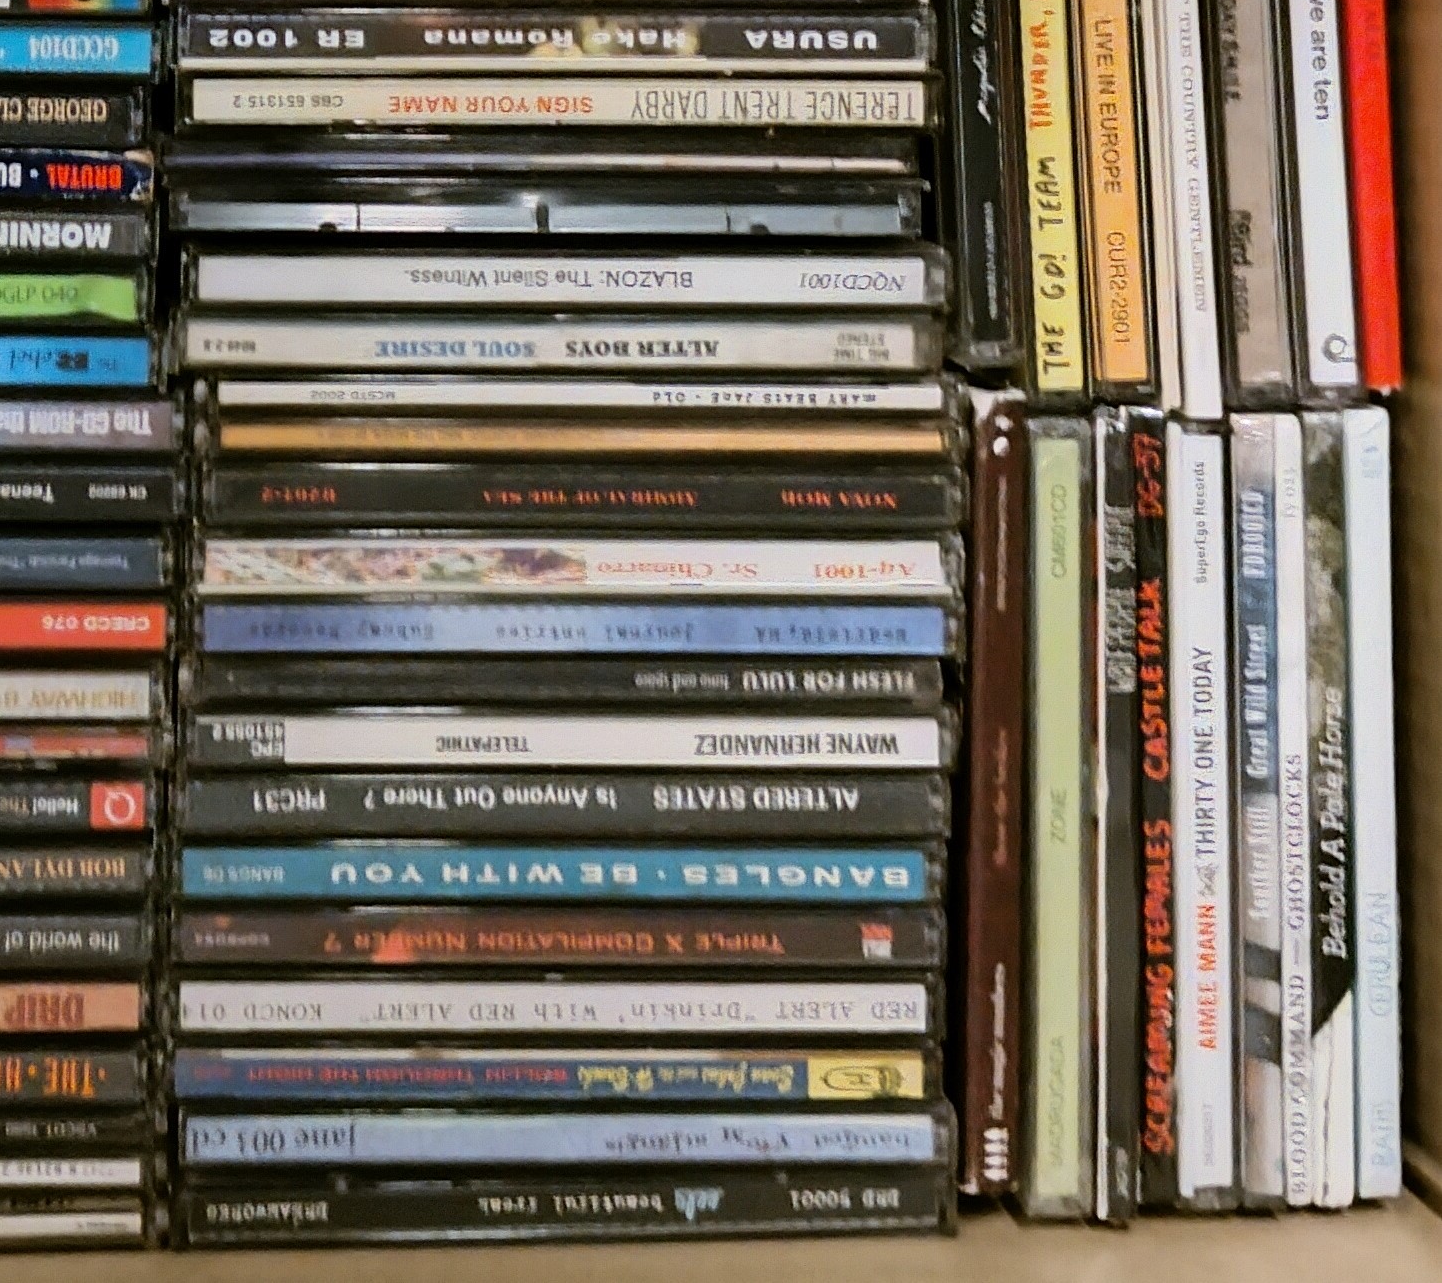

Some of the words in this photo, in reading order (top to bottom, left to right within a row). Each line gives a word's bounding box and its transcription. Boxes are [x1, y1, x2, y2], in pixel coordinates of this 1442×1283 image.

[208, 29, 298, 49] 1002
[317, 29, 364, 49] ER
[423, 28, 574, 49] Romana
[743, 29, 878, 50] USURA
[1092, 17, 1115, 69] LIVE
[1309, 30, 1329, 74] are
[1095, 74, 1116, 97] IN
[1312, 80, 1332, 121] ten
[1097, 101, 1122, 195] EUROPE
[46, 162, 123, 190] BRUTAL
[1037, 155, 1064, 230] TEAM
[493, 268, 550, 288] Silent
[556, 269, 592, 288] The
[598, 269, 693, 288] BLAZON:
[1043, 252, 1067, 299] GO!
[1043, 323, 1069, 374] THE
[29, 409, 110, 434] CD-ROM
[114, 410, 151, 436] The
[1193, 461, 1206, 516] Records
[1138, 579, 1165, 664] TALK
[1191, 646, 1214, 717] TODAY
[1141, 664, 1169, 780] CASTLE
[1320, 686, 1344, 764] Horse
[435, 735, 529, 753] TELEPATHIC
[694, 732, 821, 757] HERNANDEZ
[827, 733, 899, 757] WAYNE
[1194, 725, 1216, 770] ONE
[383, 786, 447, 809] There
[454, 786, 496, 808] Out
[502, 783, 589, 807] Anyone
[596, 786, 617, 807] Is
[653, 786, 745, 810] STATES
[752, 786, 859, 810] ALTERED
[1320, 770, 1348, 832] Pale
[1195, 776, 1216, 859] THIRTY
[1322, 840, 1345, 858] A
[330, 860, 423, 884] YOU
[441, 862, 563, 885] WITH
[576, 862, 638, 885] BE
[681, 864, 909, 887] BANGLES
[1143, 819, 1173, 955] FEMALES
[1322, 863, 1348, 958] Behold
[1196, 904, 1217, 971] MANN
[1196, 978, 1218, 1050] AIMEE
[1144, 964, 1173, 1152] SCREAMING
